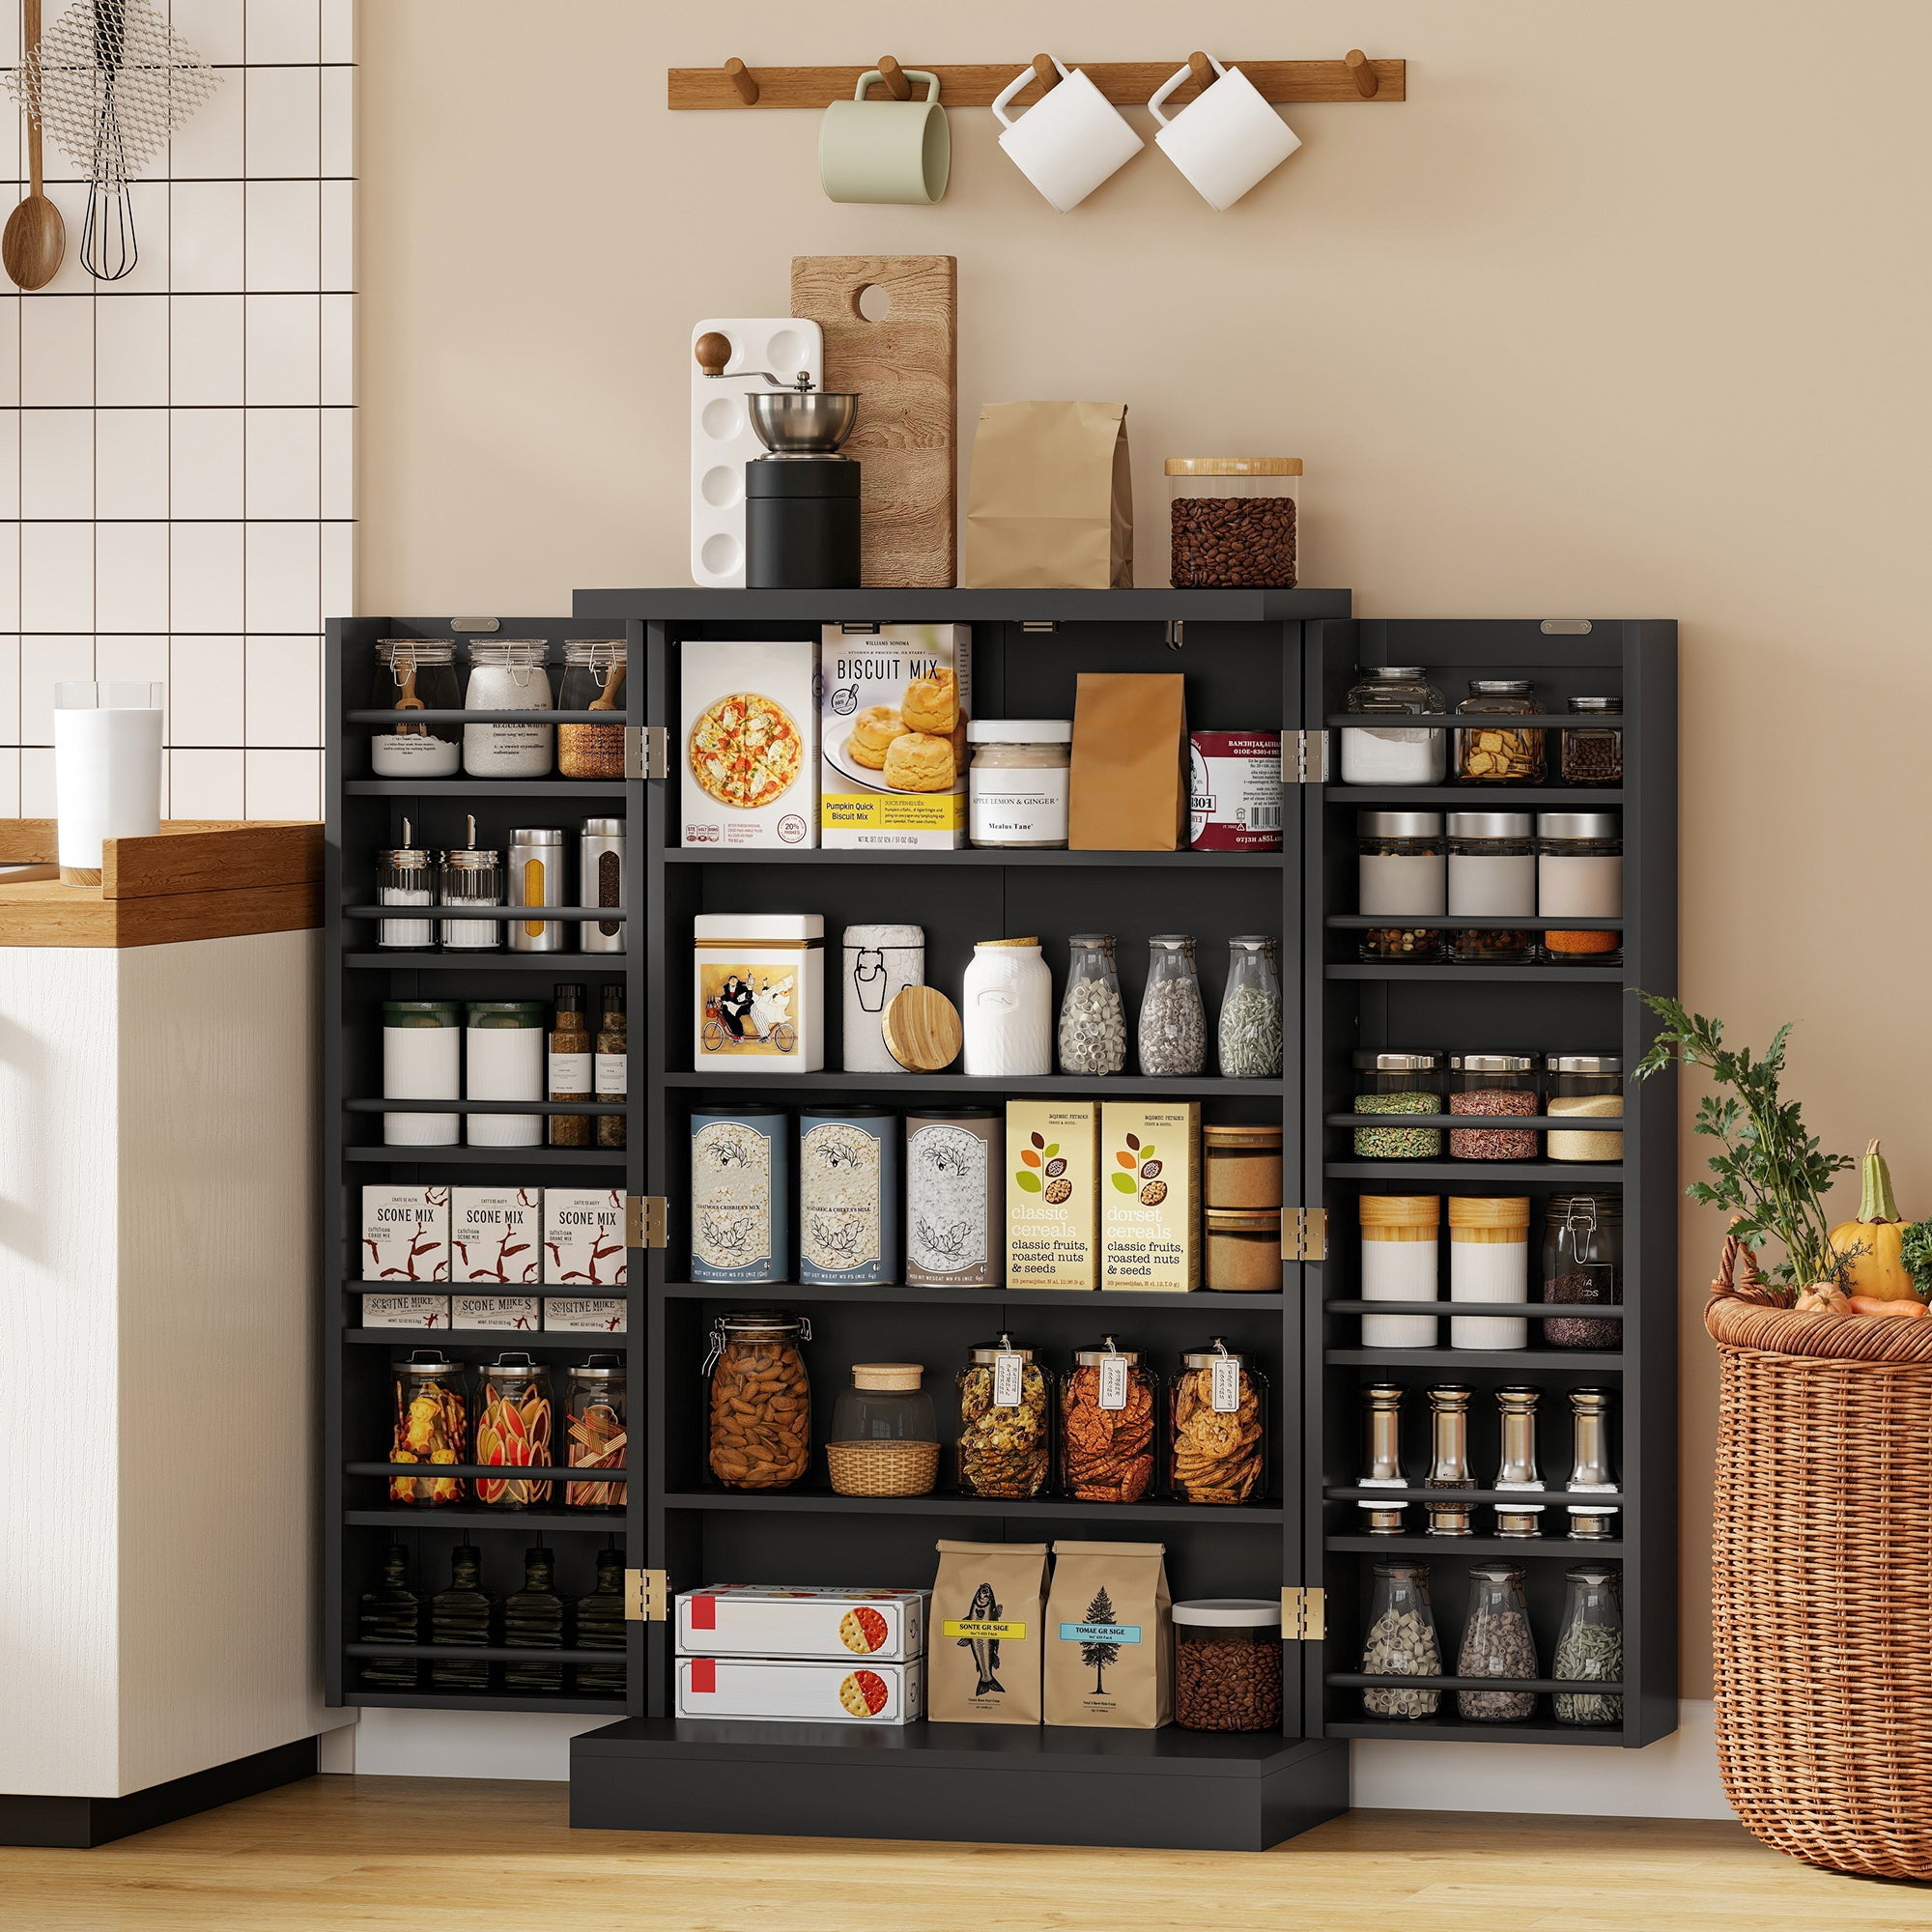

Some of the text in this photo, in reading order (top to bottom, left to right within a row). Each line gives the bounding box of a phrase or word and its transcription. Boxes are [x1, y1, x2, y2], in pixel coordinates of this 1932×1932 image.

[838, 659, 938, 680] BISCUIT MIX
[377, 1208, 434, 1222] SCONE MIX
[467, 1209, 524, 1224] SCONE MIX
[559, 1210, 616, 1226] SCONE MIX
[1011, 1205, 1068, 1220] classic
[1107, 1206, 1163, 1222] dorset
[1011, 1222, 1076, 1236] cereals
[1107, 1223, 1172, 1239] cereals
[1011, 1239, 1088, 1252] classic fruits,
[1107, 1241, 1184, 1254] classic fruits,
[1011, 1252, 1084, 1263] roasted nuts
[1107, 1254, 1180, 1264] roasted nuts
[1011, 1263, 1056, 1273] & seeds
[1107, 1264, 1151, 1275] & seeds
[463, 1299, 495, 1311] SCONE
[525, 1298, 531, 1310] S
